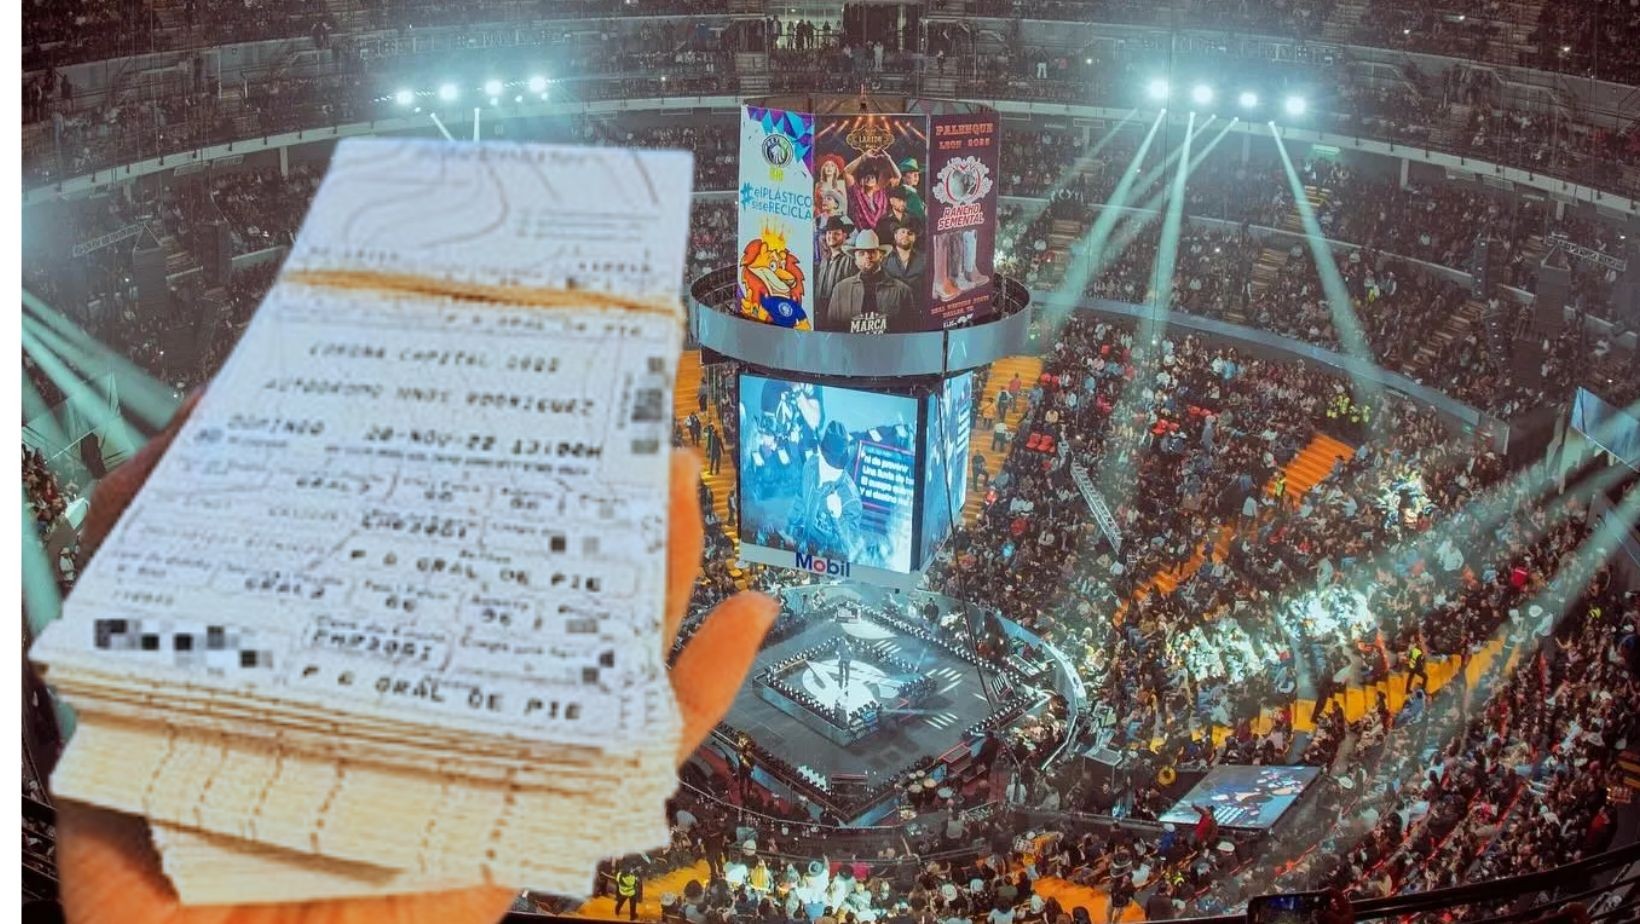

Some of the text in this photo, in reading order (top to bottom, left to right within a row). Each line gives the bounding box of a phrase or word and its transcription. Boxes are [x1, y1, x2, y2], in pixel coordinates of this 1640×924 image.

[943, 203, 982, 219] RANCHO
[937, 213, 985, 231] SEMENTAL
[850, 319, 887, 333] MARCA
[796, 552, 851, 577] Mobil
[374, 675, 445, 703] GRAL
[524, 698, 582, 721] PIE
